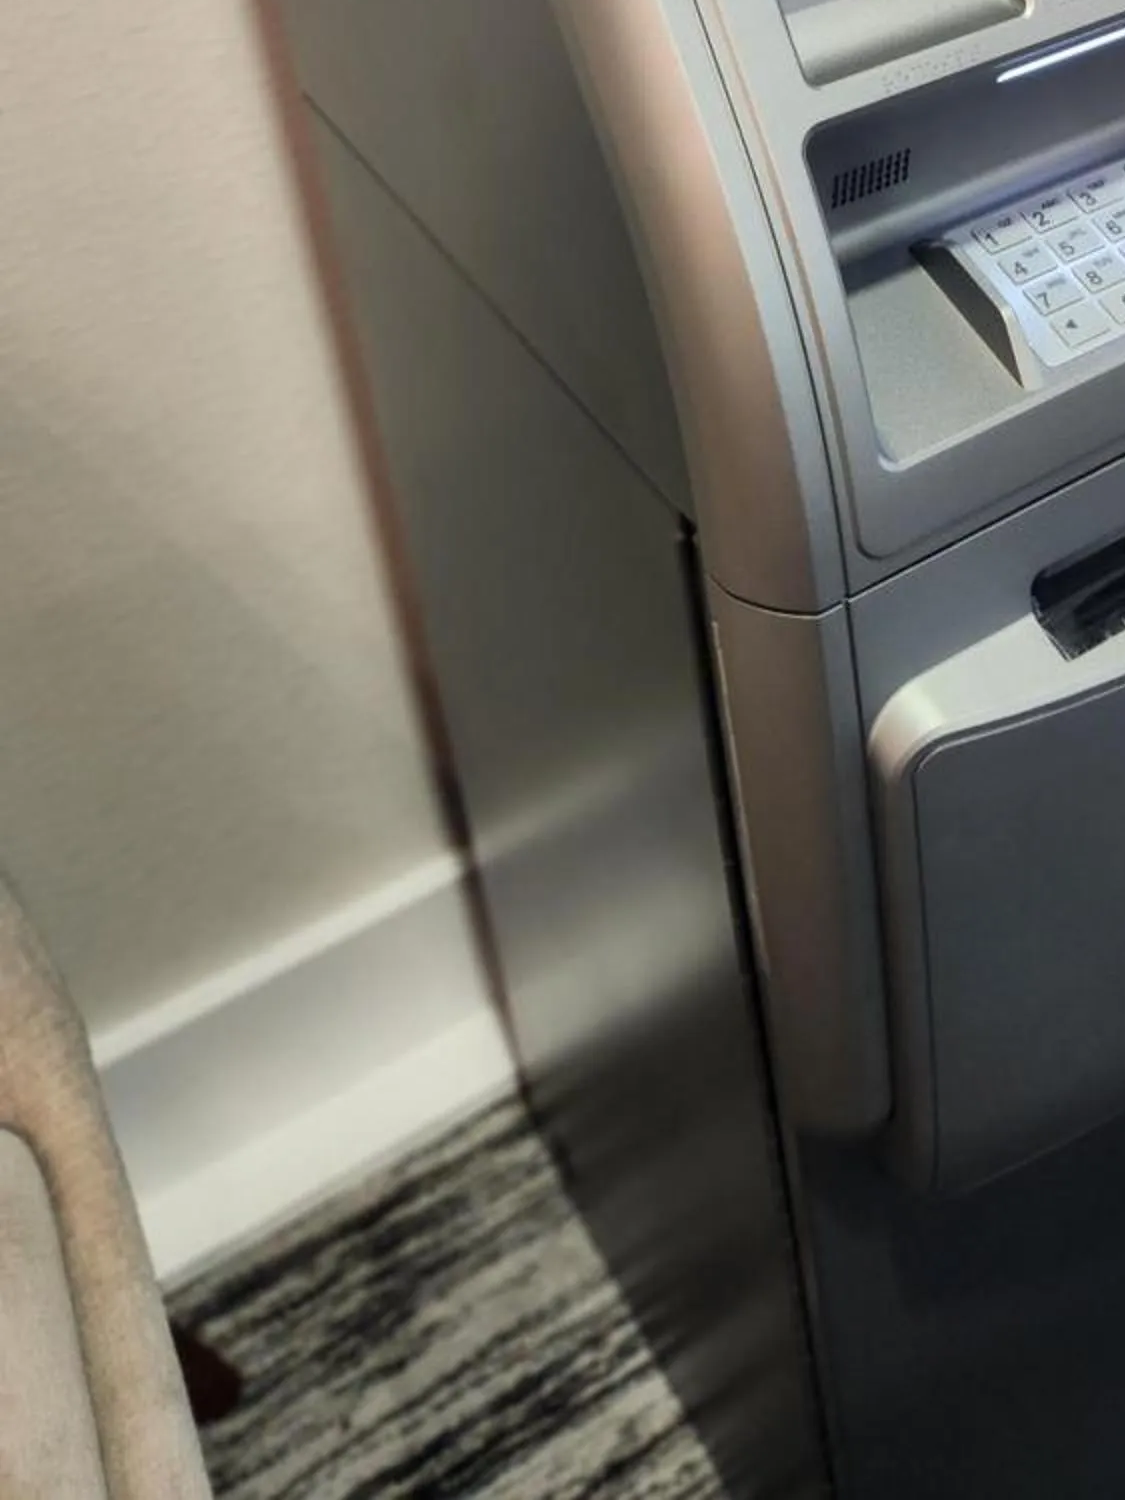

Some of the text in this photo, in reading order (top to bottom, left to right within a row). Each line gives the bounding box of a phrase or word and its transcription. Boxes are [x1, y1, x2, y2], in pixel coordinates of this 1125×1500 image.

[1032, 210, 1052, 227] 2
[1105, 219, 1123, 235] 6
[1058, 241, 1075, 256] 5
[1014, 260, 1030, 276] 4
[1085, 270, 1103, 286] 8
[1036, 291, 1052, 310] 7
